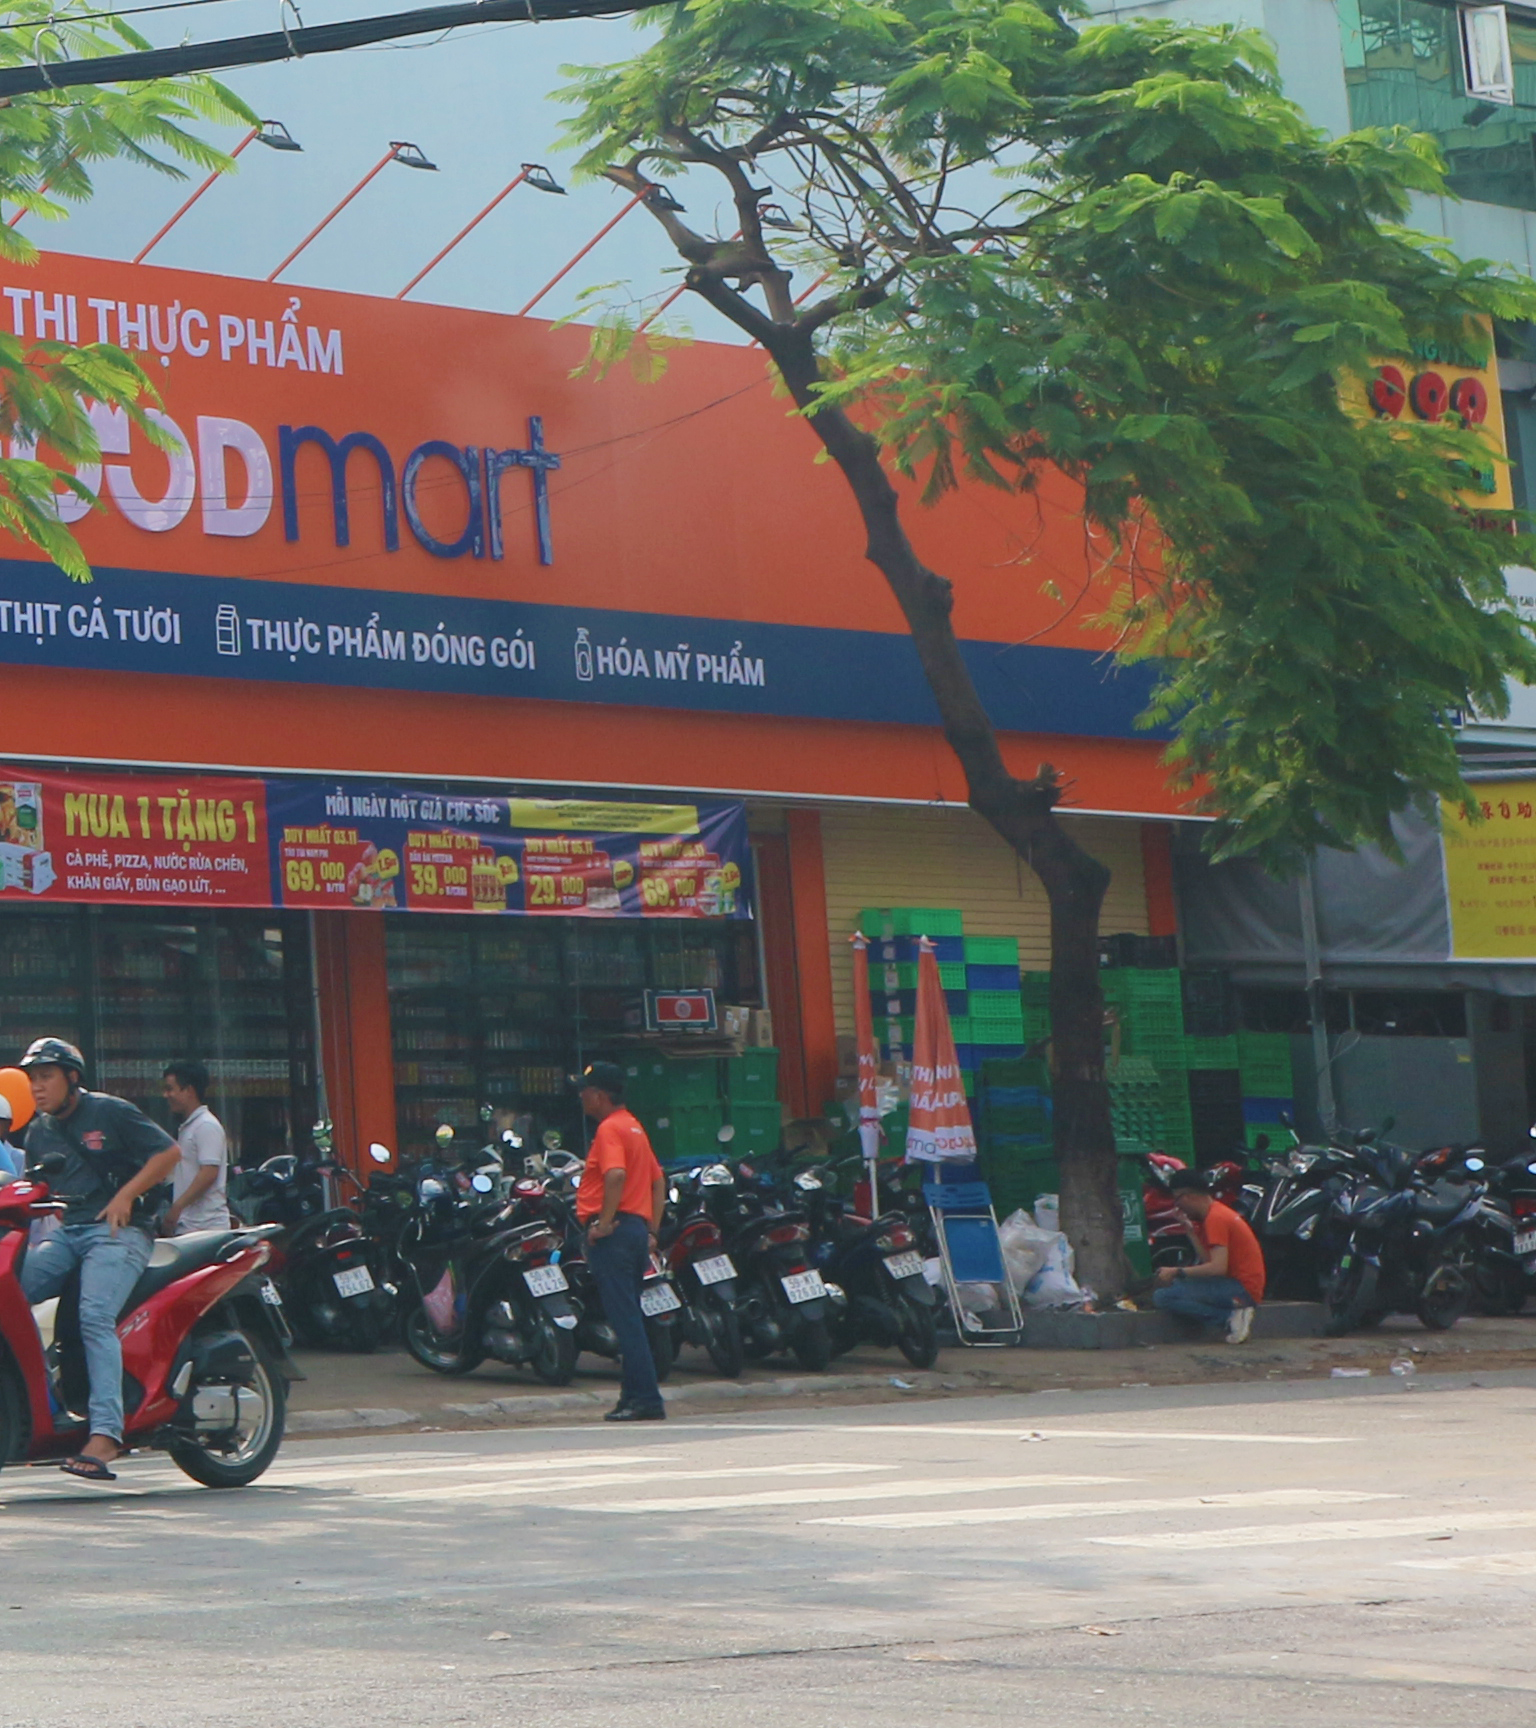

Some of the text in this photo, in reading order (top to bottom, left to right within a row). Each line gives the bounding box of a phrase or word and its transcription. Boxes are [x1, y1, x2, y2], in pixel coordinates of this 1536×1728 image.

[3, 286, 79, 346] THỊ
[97, 295, 210, 369] THỰC
[218, 295, 345, 376] PHẨM
[68, 596, 109, 639] CÁ
[113, 603, 180, 646] TƯƠI
[246, 610, 535, 671] THỰC PHẨM ĐÓNG GÓI
[596, 638, 765, 688] HÓA MỸ PHẨM
[65, 788, 256, 853] MUA 1 TẶNG 1
[325, 786, 501, 825] MỖI NGÀY MỘT GIÁ CỰC SỐC
[66, 848, 248, 874] CÀ PHÊ, PIZZA, NƯỚC RỬA CHÉN,
[67, 872, 213, 896] KHĂN GIẤY, BÚN GẠO LỨT,
